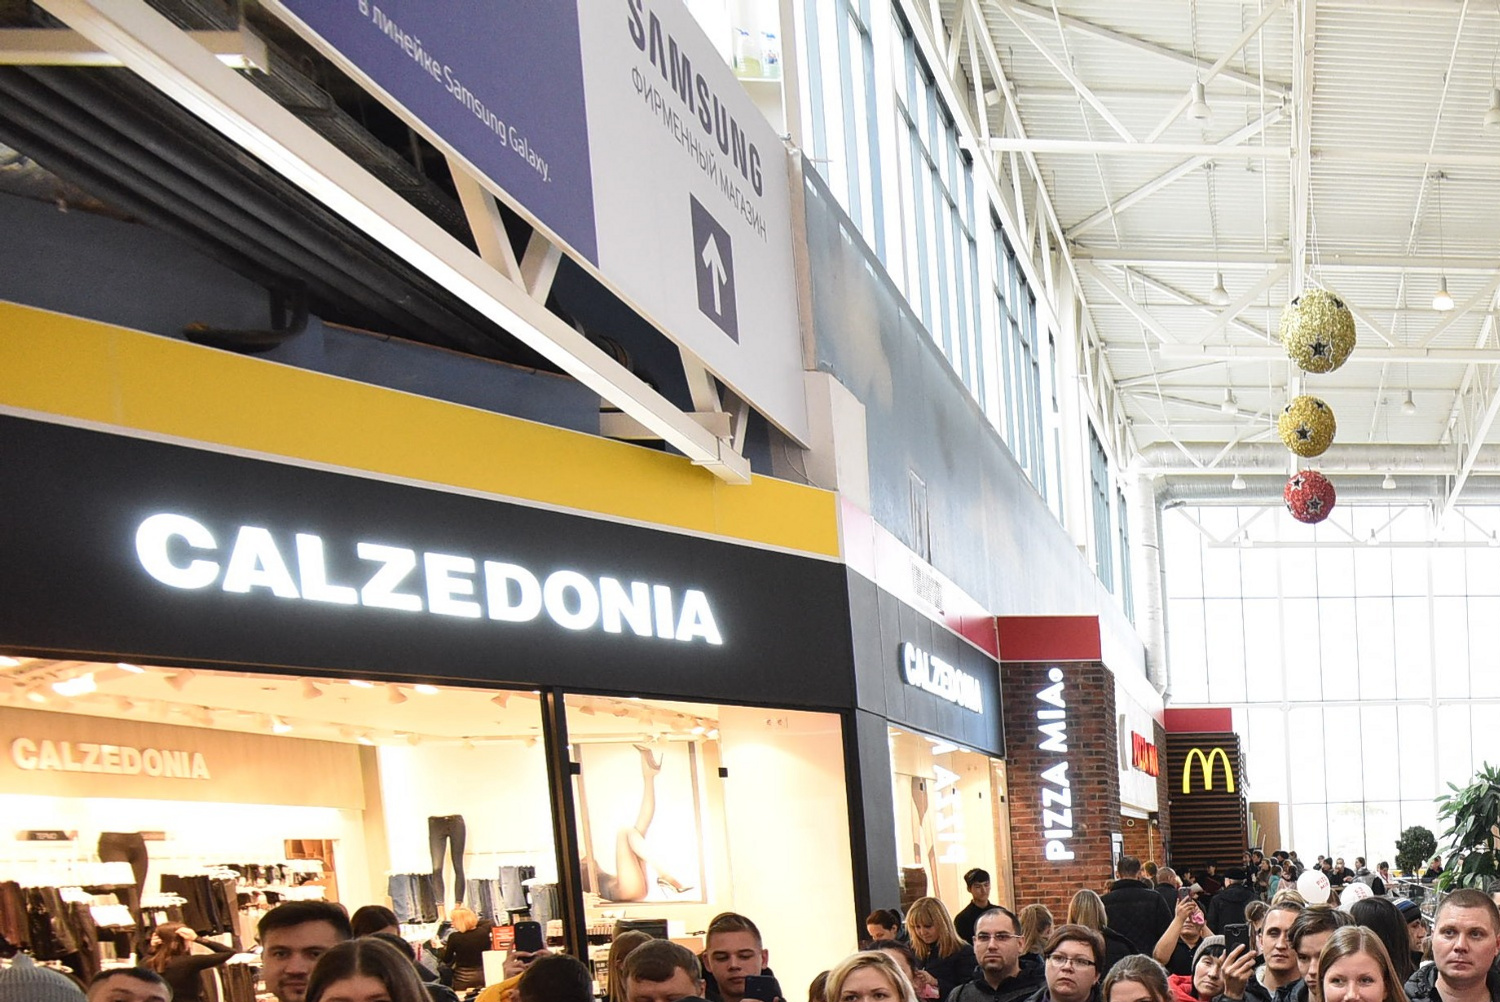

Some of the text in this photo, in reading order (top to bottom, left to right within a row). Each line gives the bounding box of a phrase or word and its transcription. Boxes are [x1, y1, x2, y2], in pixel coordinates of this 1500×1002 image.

[372, 5, 442, 83] линейке
[443, 64, 507, 146] Samsung
[508, 126, 552, 183] Galaxy.
[627, 0, 764, 197] SAMSUNG
[631, 65, 768, 243] ФИРМЕННЫЙ МАГАЗИН
[134, 512, 724, 646] CALZEDONIA
[12, 737, 211, 781] CALZEDONIA
[1036, 682, 1075, 861] PIZZA MIA
